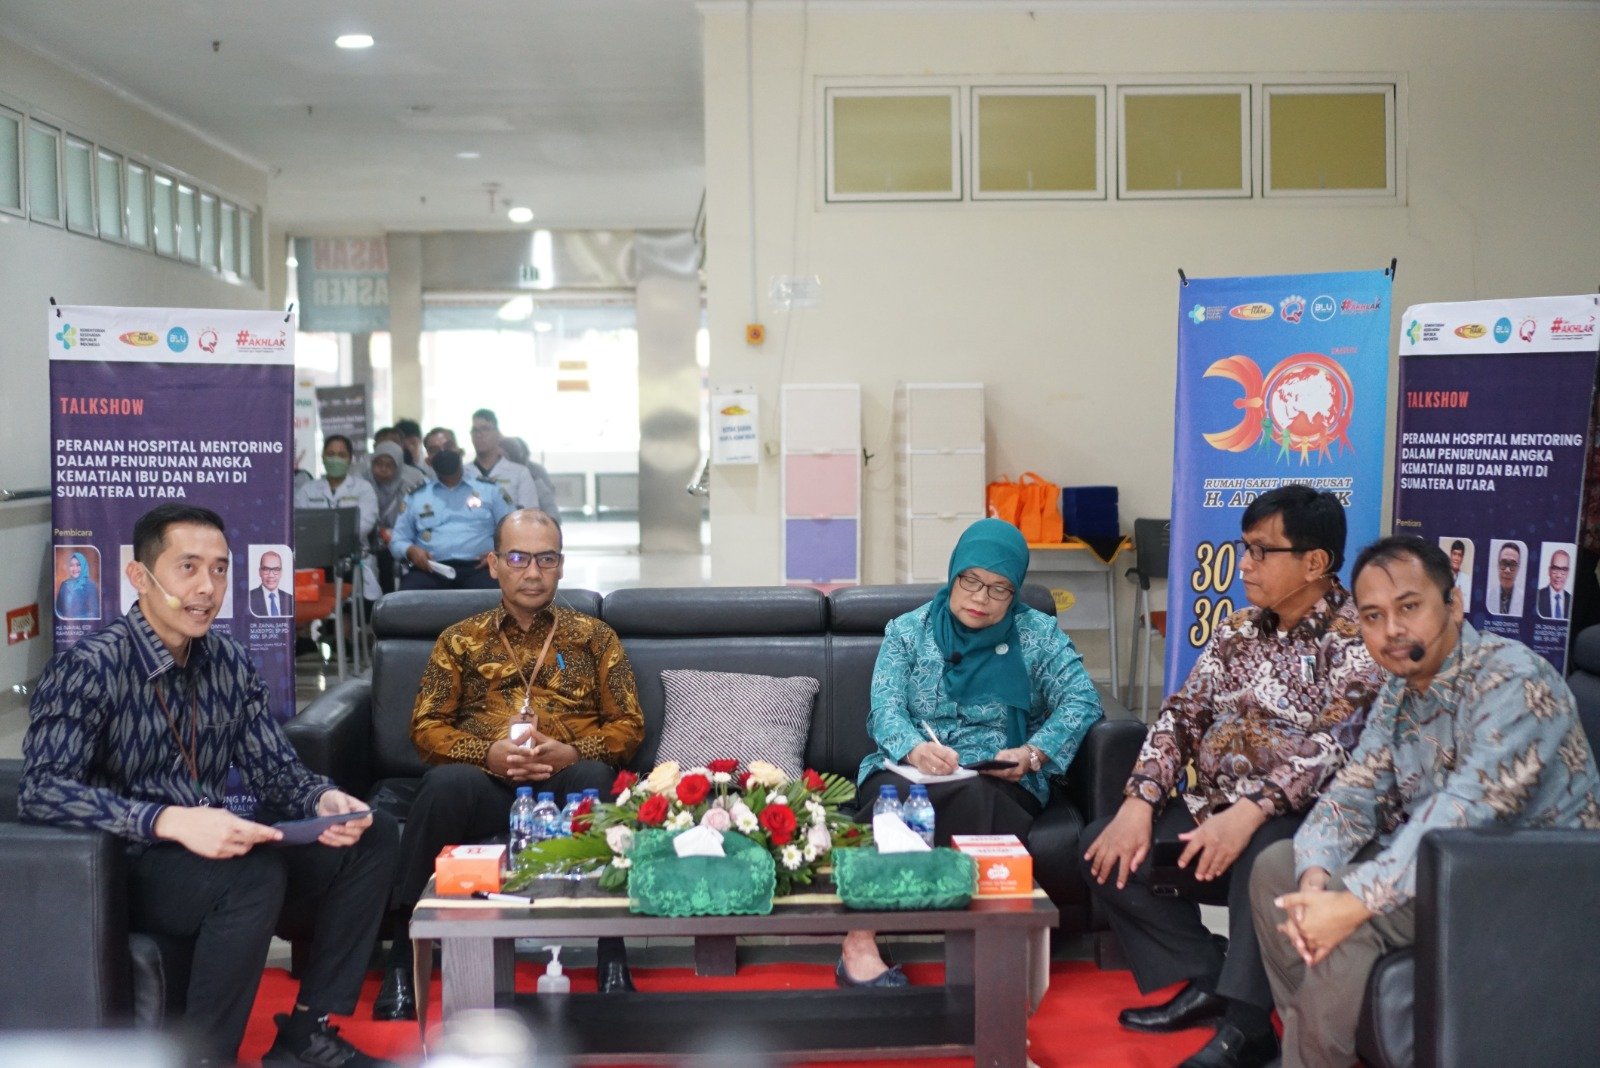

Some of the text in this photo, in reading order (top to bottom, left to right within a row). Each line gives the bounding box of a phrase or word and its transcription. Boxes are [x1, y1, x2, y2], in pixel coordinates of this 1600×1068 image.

[1315, 303, 1333, 311] BLU
[1407, 391, 1469, 408] TALKSHOW
[60, 397, 144, 416] TALKSHOW
[56, 439, 283, 453] PERANAN HOSPITAL MENTORING
[1403, 433, 1583, 446] PERANAN HOSPITAL MENTORING
[1402, 448, 1554, 461] DALAM PENURUNAN ANGKA
[56, 455, 252, 468] DALAM PENURUNAN ANGKA
[56, 470, 247, 483] KEMATIAN IBU DAN BAYI DI
[1401, 463, 1548, 477] KEMATIAN IBU DAN BAYI DI
[1205, 479, 1243, 489] RUMAH
[1245, 479, 1279, 488] SAKIT
[1315, 478, 1352, 488] PUSAT
[1401, 477, 1495, 491] SUMATERA UTARA
[56, 485, 186, 498] SUMATERA UTARA
[1203, 491, 1224, 507] H.
[54, 528, 93, 537] Pembicara
[1191, 540, 1236, 594] 30
[1190, 596, 1234, 648] 30
